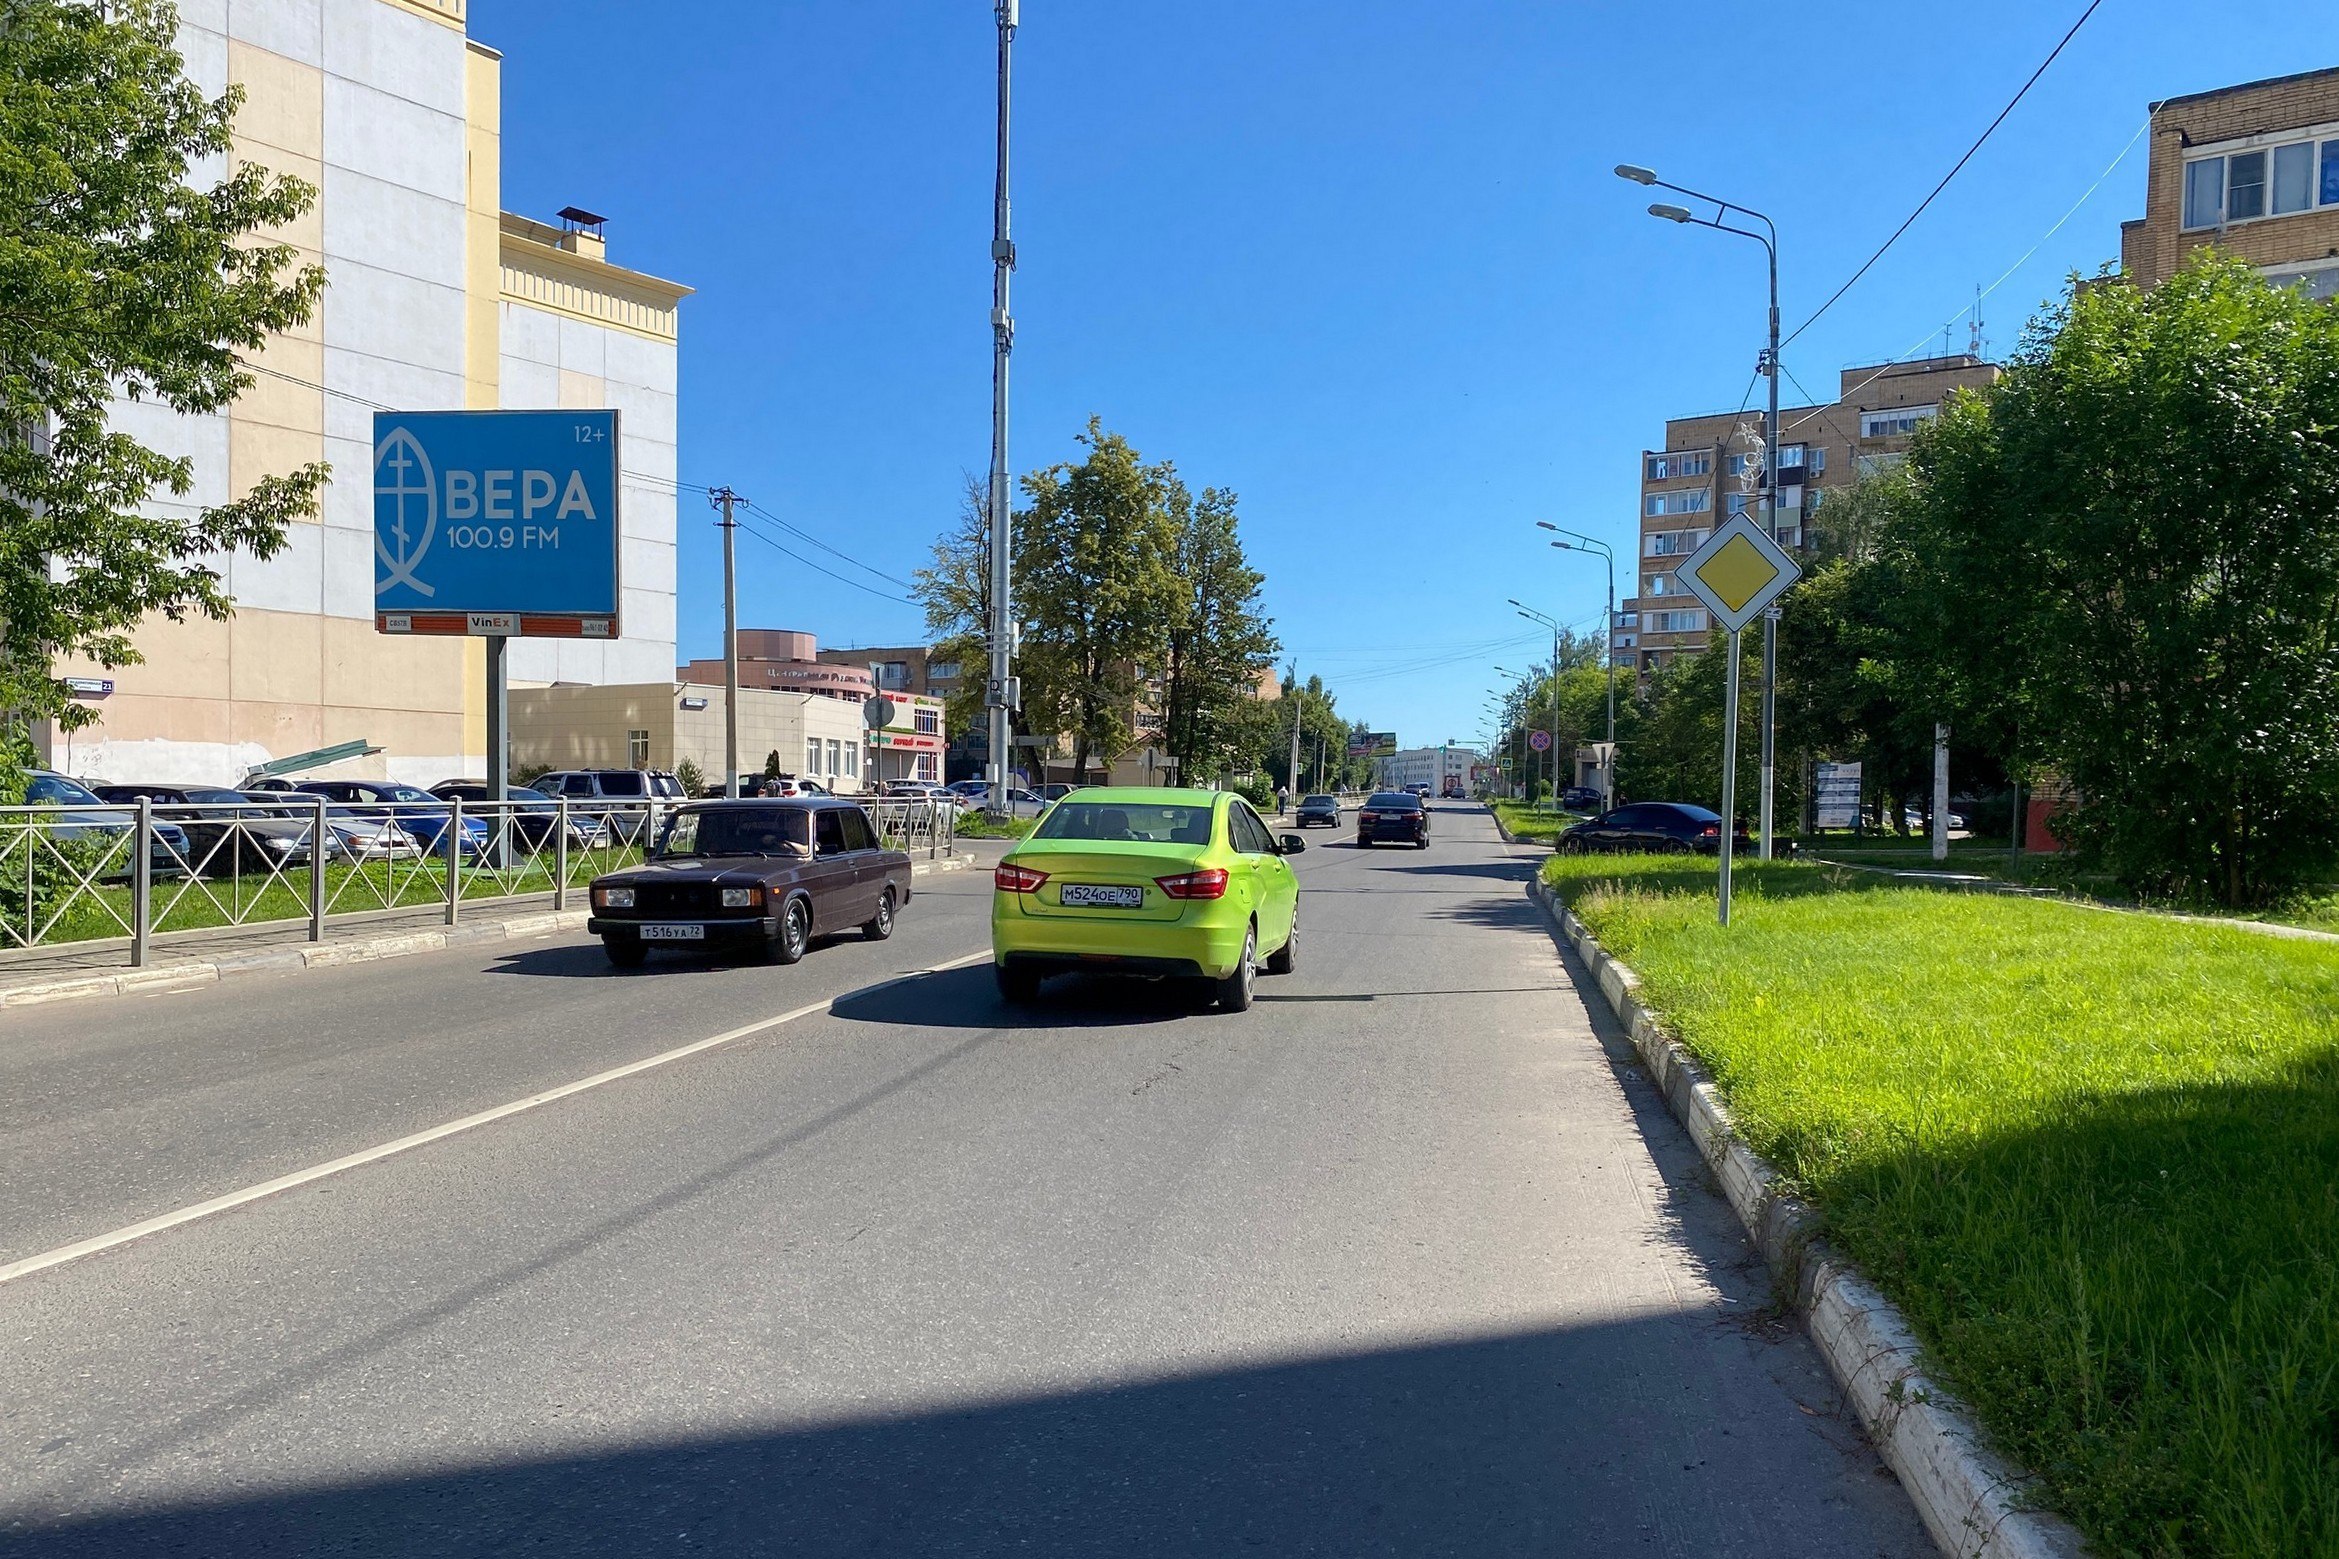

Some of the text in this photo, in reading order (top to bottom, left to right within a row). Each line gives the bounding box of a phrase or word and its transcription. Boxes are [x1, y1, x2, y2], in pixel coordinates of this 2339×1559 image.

[574, 426, 605, 443] 12+
[445, 470, 597, 520] ВЕРА
[446, 526, 560, 549] 100.9 FM
[471, 617, 510, 627] VinEx
[1118, 888, 1138, 899] 790
[689, 926, 700, 935] 72
